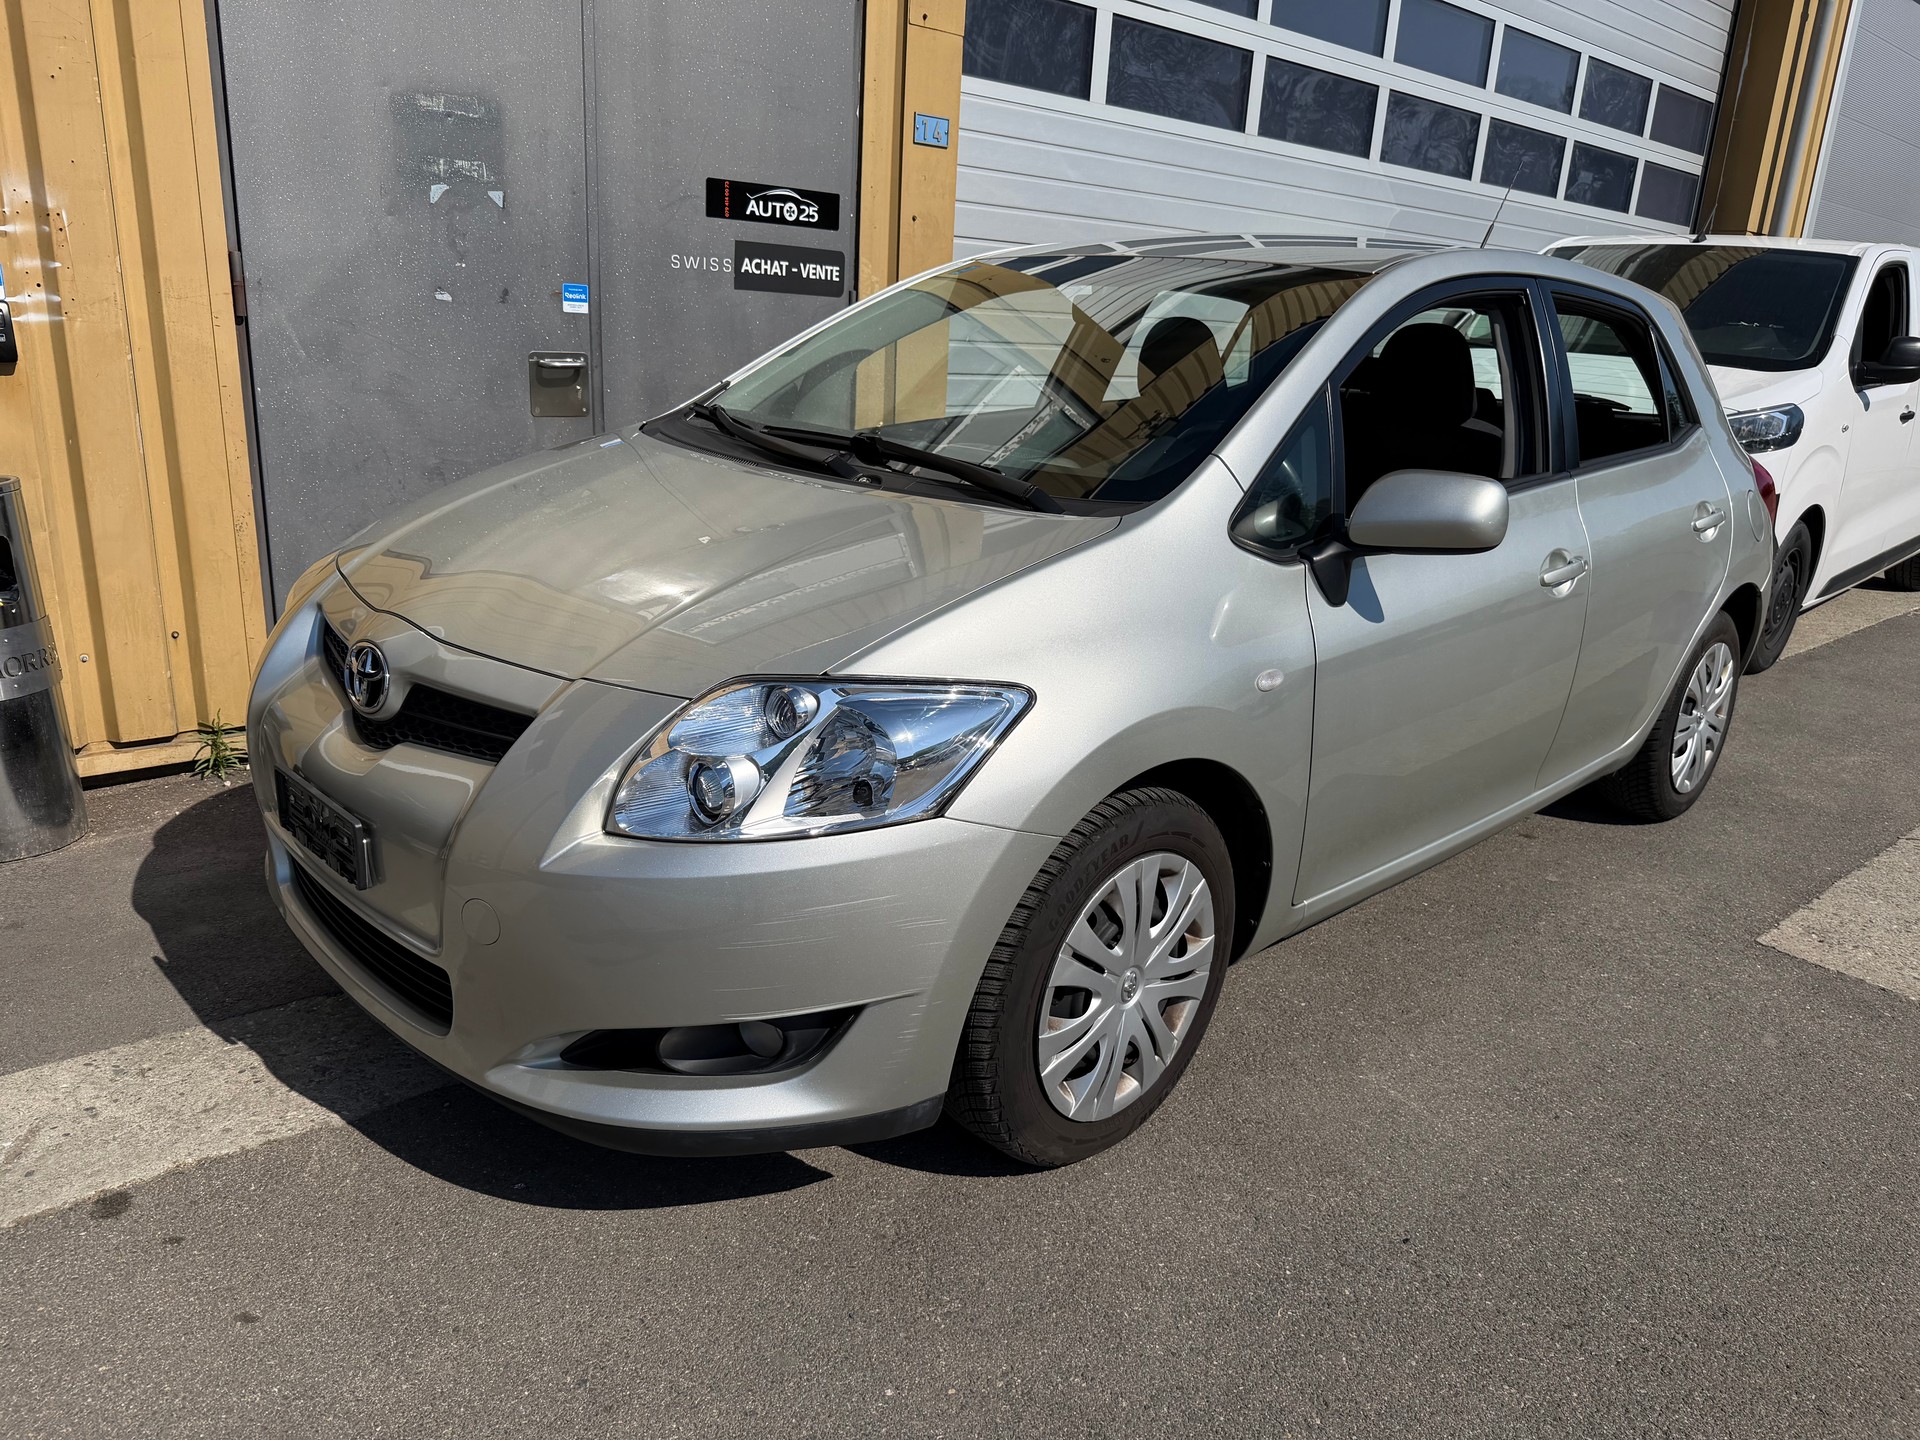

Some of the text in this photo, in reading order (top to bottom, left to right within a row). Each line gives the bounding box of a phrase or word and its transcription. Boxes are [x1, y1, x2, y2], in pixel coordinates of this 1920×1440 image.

[921, 119, 943, 142] 14
[671, 254, 732, 273] SWISS
[741, 257, 789, 276] ACHAT
[800, 262, 840, 281] VENTE
[1048, 834, 1130, 932] GOODYEAR
